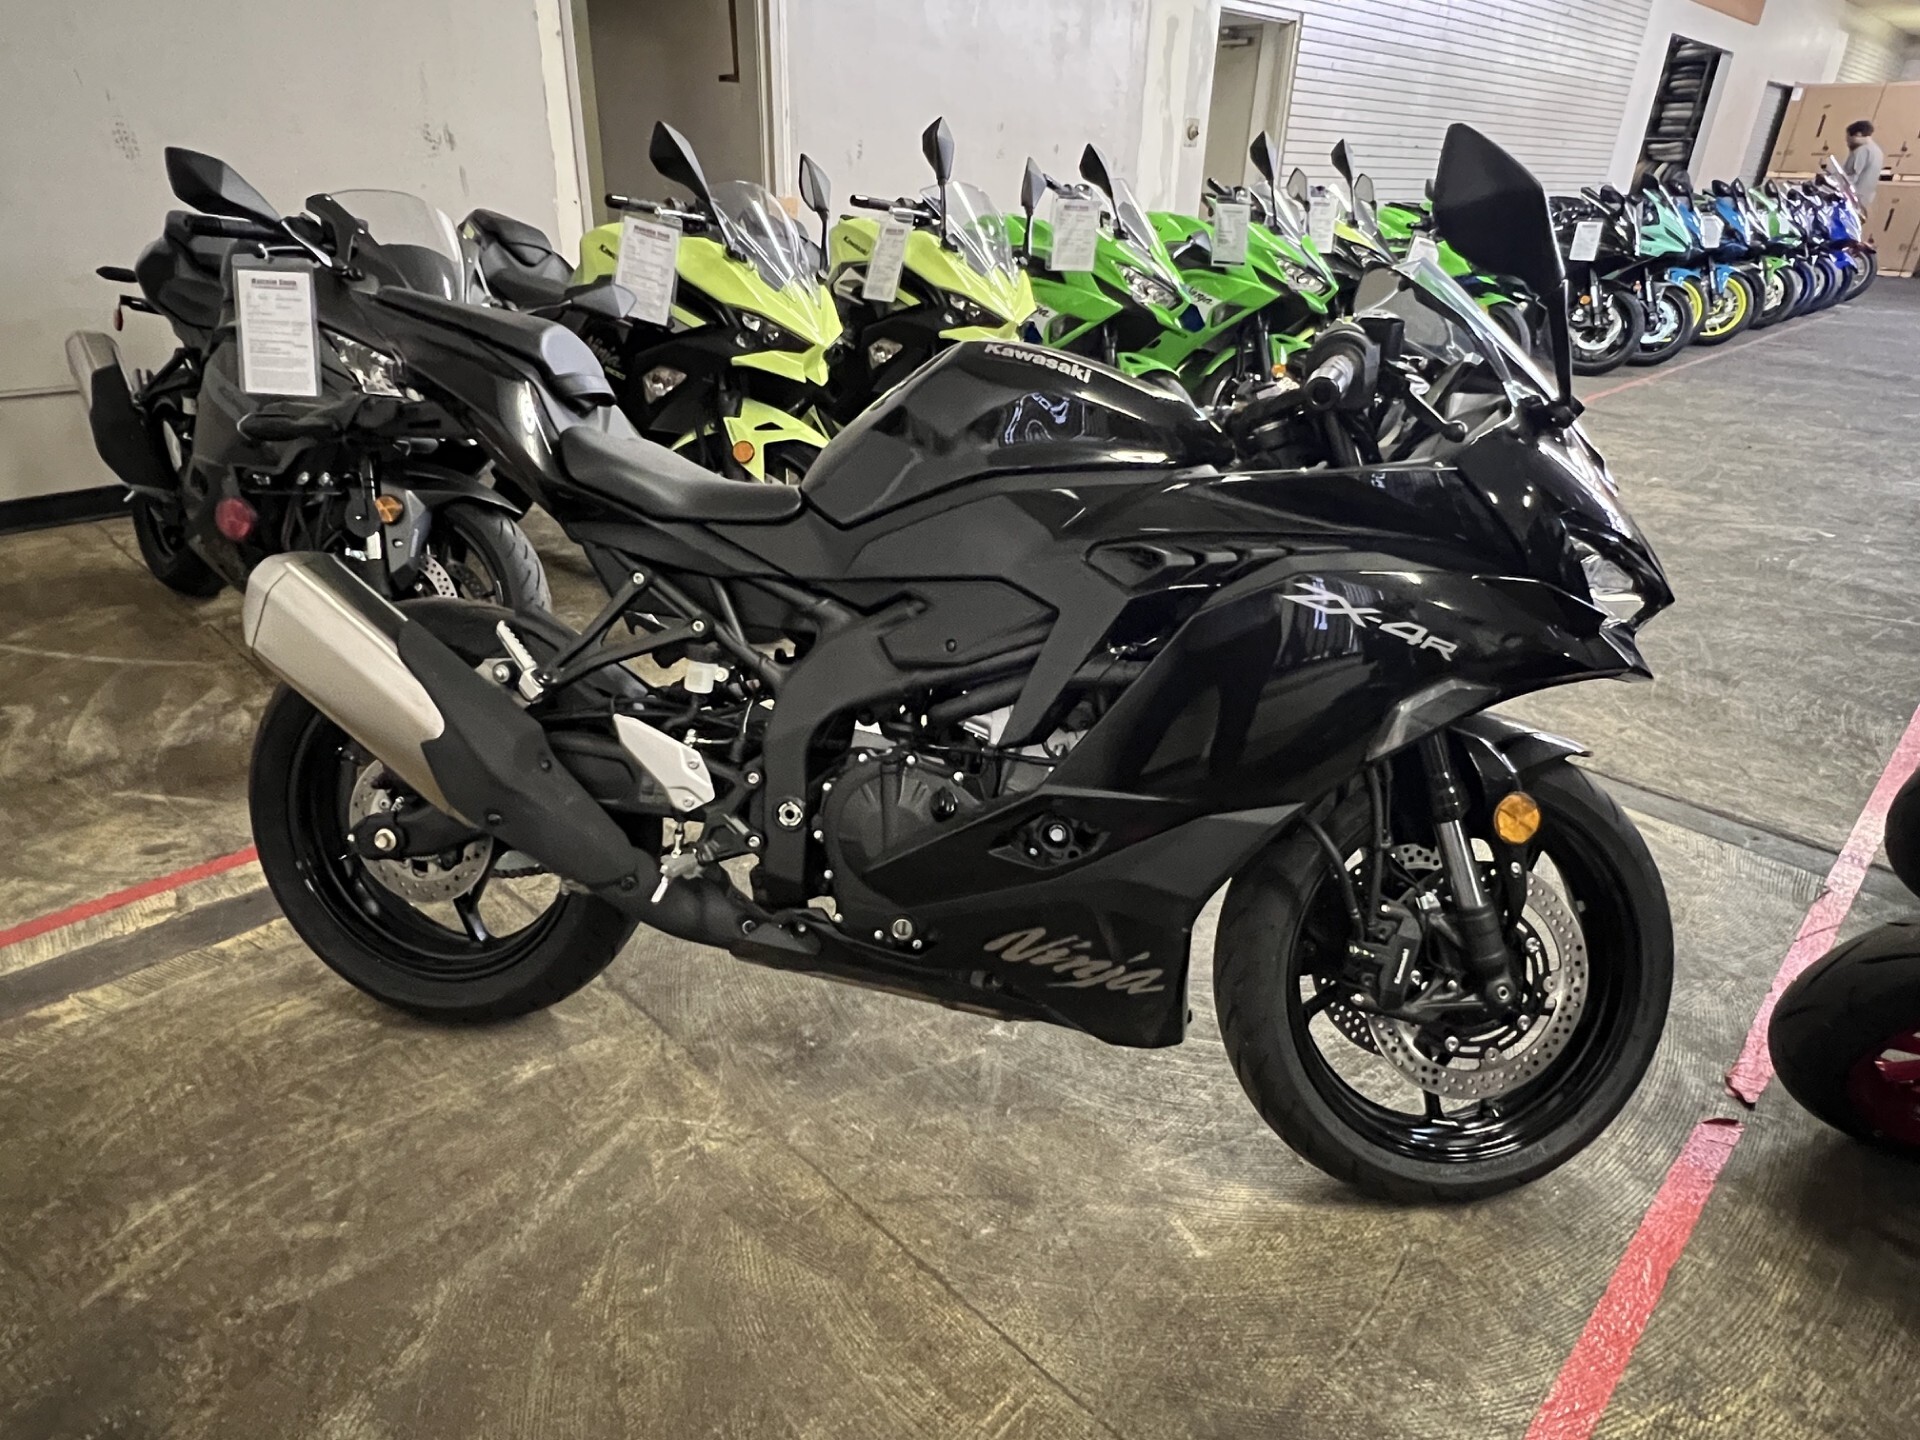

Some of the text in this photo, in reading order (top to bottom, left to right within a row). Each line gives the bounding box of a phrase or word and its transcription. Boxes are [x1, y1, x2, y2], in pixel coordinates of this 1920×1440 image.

[984, 343, 1092, 384] Kawasaki
[1282, 583, 1458, 662] ZX-4R
[983, 927, 1165, 995] Ninja
